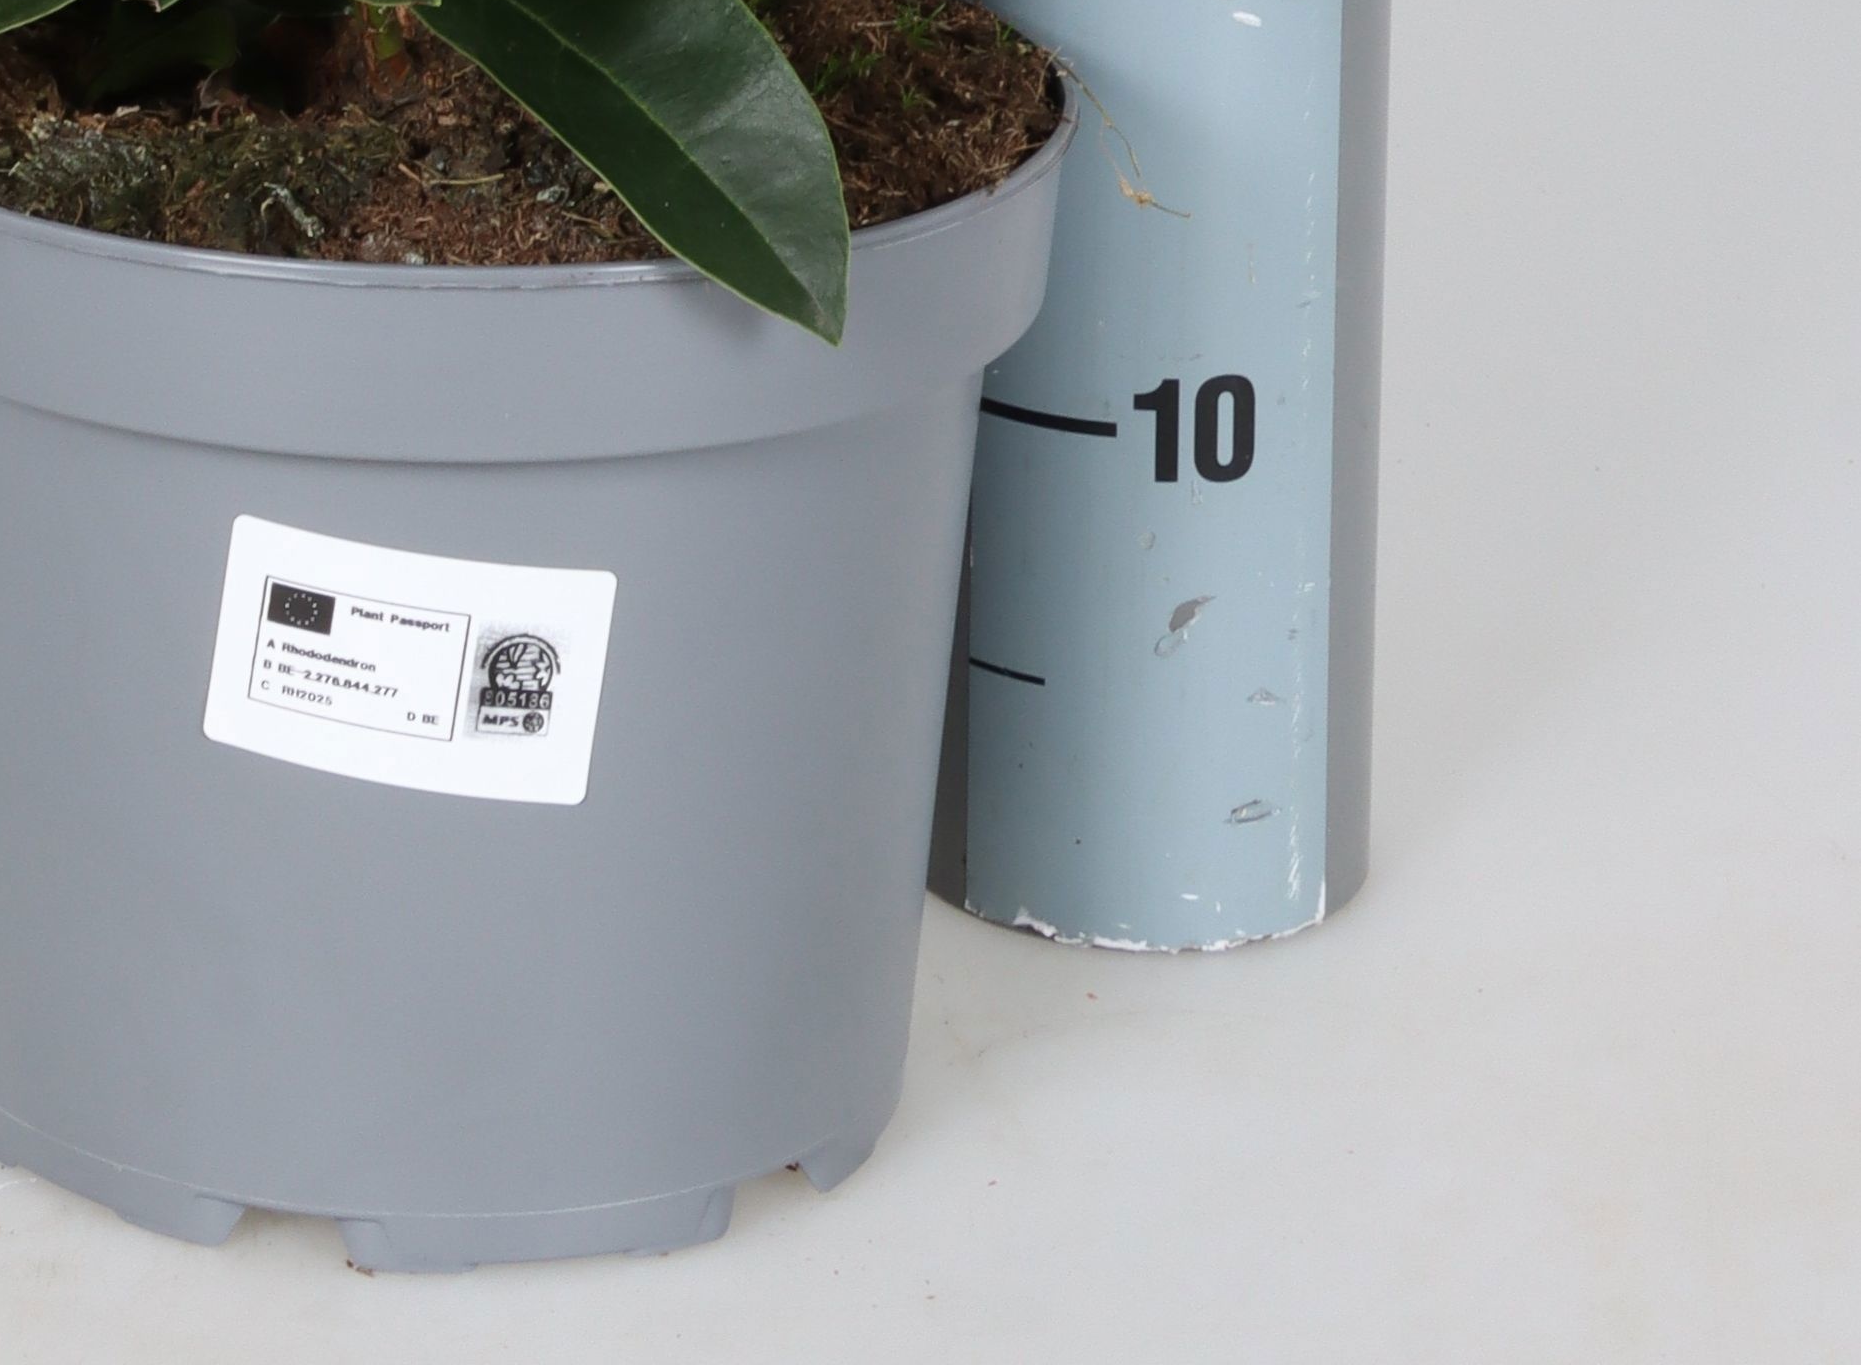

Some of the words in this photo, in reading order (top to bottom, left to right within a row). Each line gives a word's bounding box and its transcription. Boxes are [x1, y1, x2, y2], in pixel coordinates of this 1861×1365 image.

[1132, 373, 1256, 483] 10
[350, 606, 384, 621] Plant
[390, 614, 450, 633] Passport
[263, 659, 272, 669] B
[266, 639, 275, 649] A
[282, 642, 376, 672] Rhododendron
[261, 680, 270, 690] C
[281, 685, 333, 706] RH2025
[406, 711, 416, 722] D
[422, 714, 439, 725] BE
[482, 714, 519, 727] MPS
